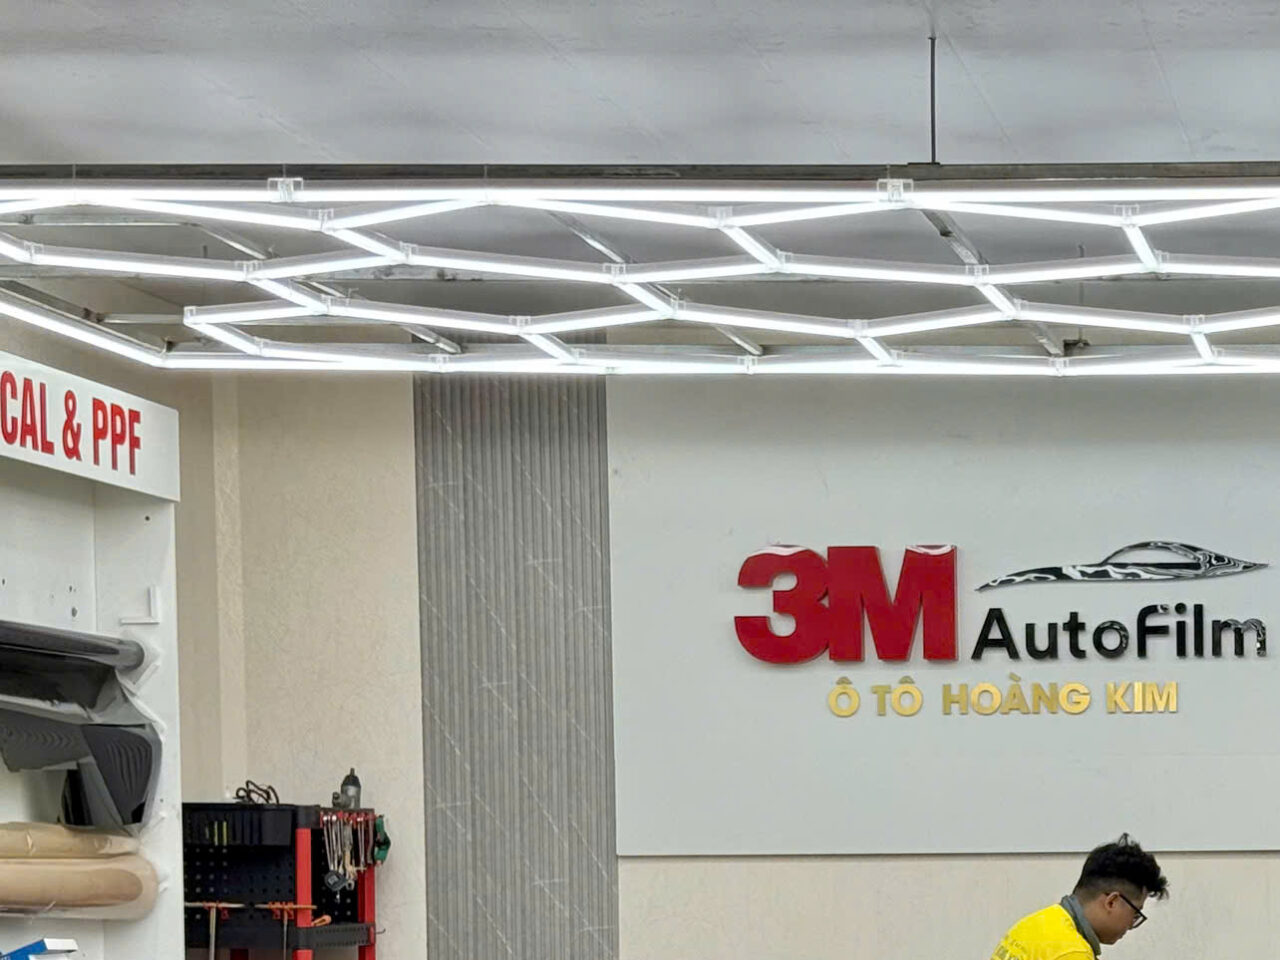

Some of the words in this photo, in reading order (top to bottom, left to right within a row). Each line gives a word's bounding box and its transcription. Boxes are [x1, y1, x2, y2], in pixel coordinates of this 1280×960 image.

[0, 370, 55, 455] CAL
[62, 389, 82, 462] &
[92, 397, 141, 476] PPF
[734, 544, 958, 664] 3M
[970, 602, 1268, 660] AutoFilm
[828, 676, 861, 717] Ô
[872, 676, 924, 717] TÔ
[942, 672, 1091, 715] HOÀNG
[1105, 681, 1179, 714] KIM
